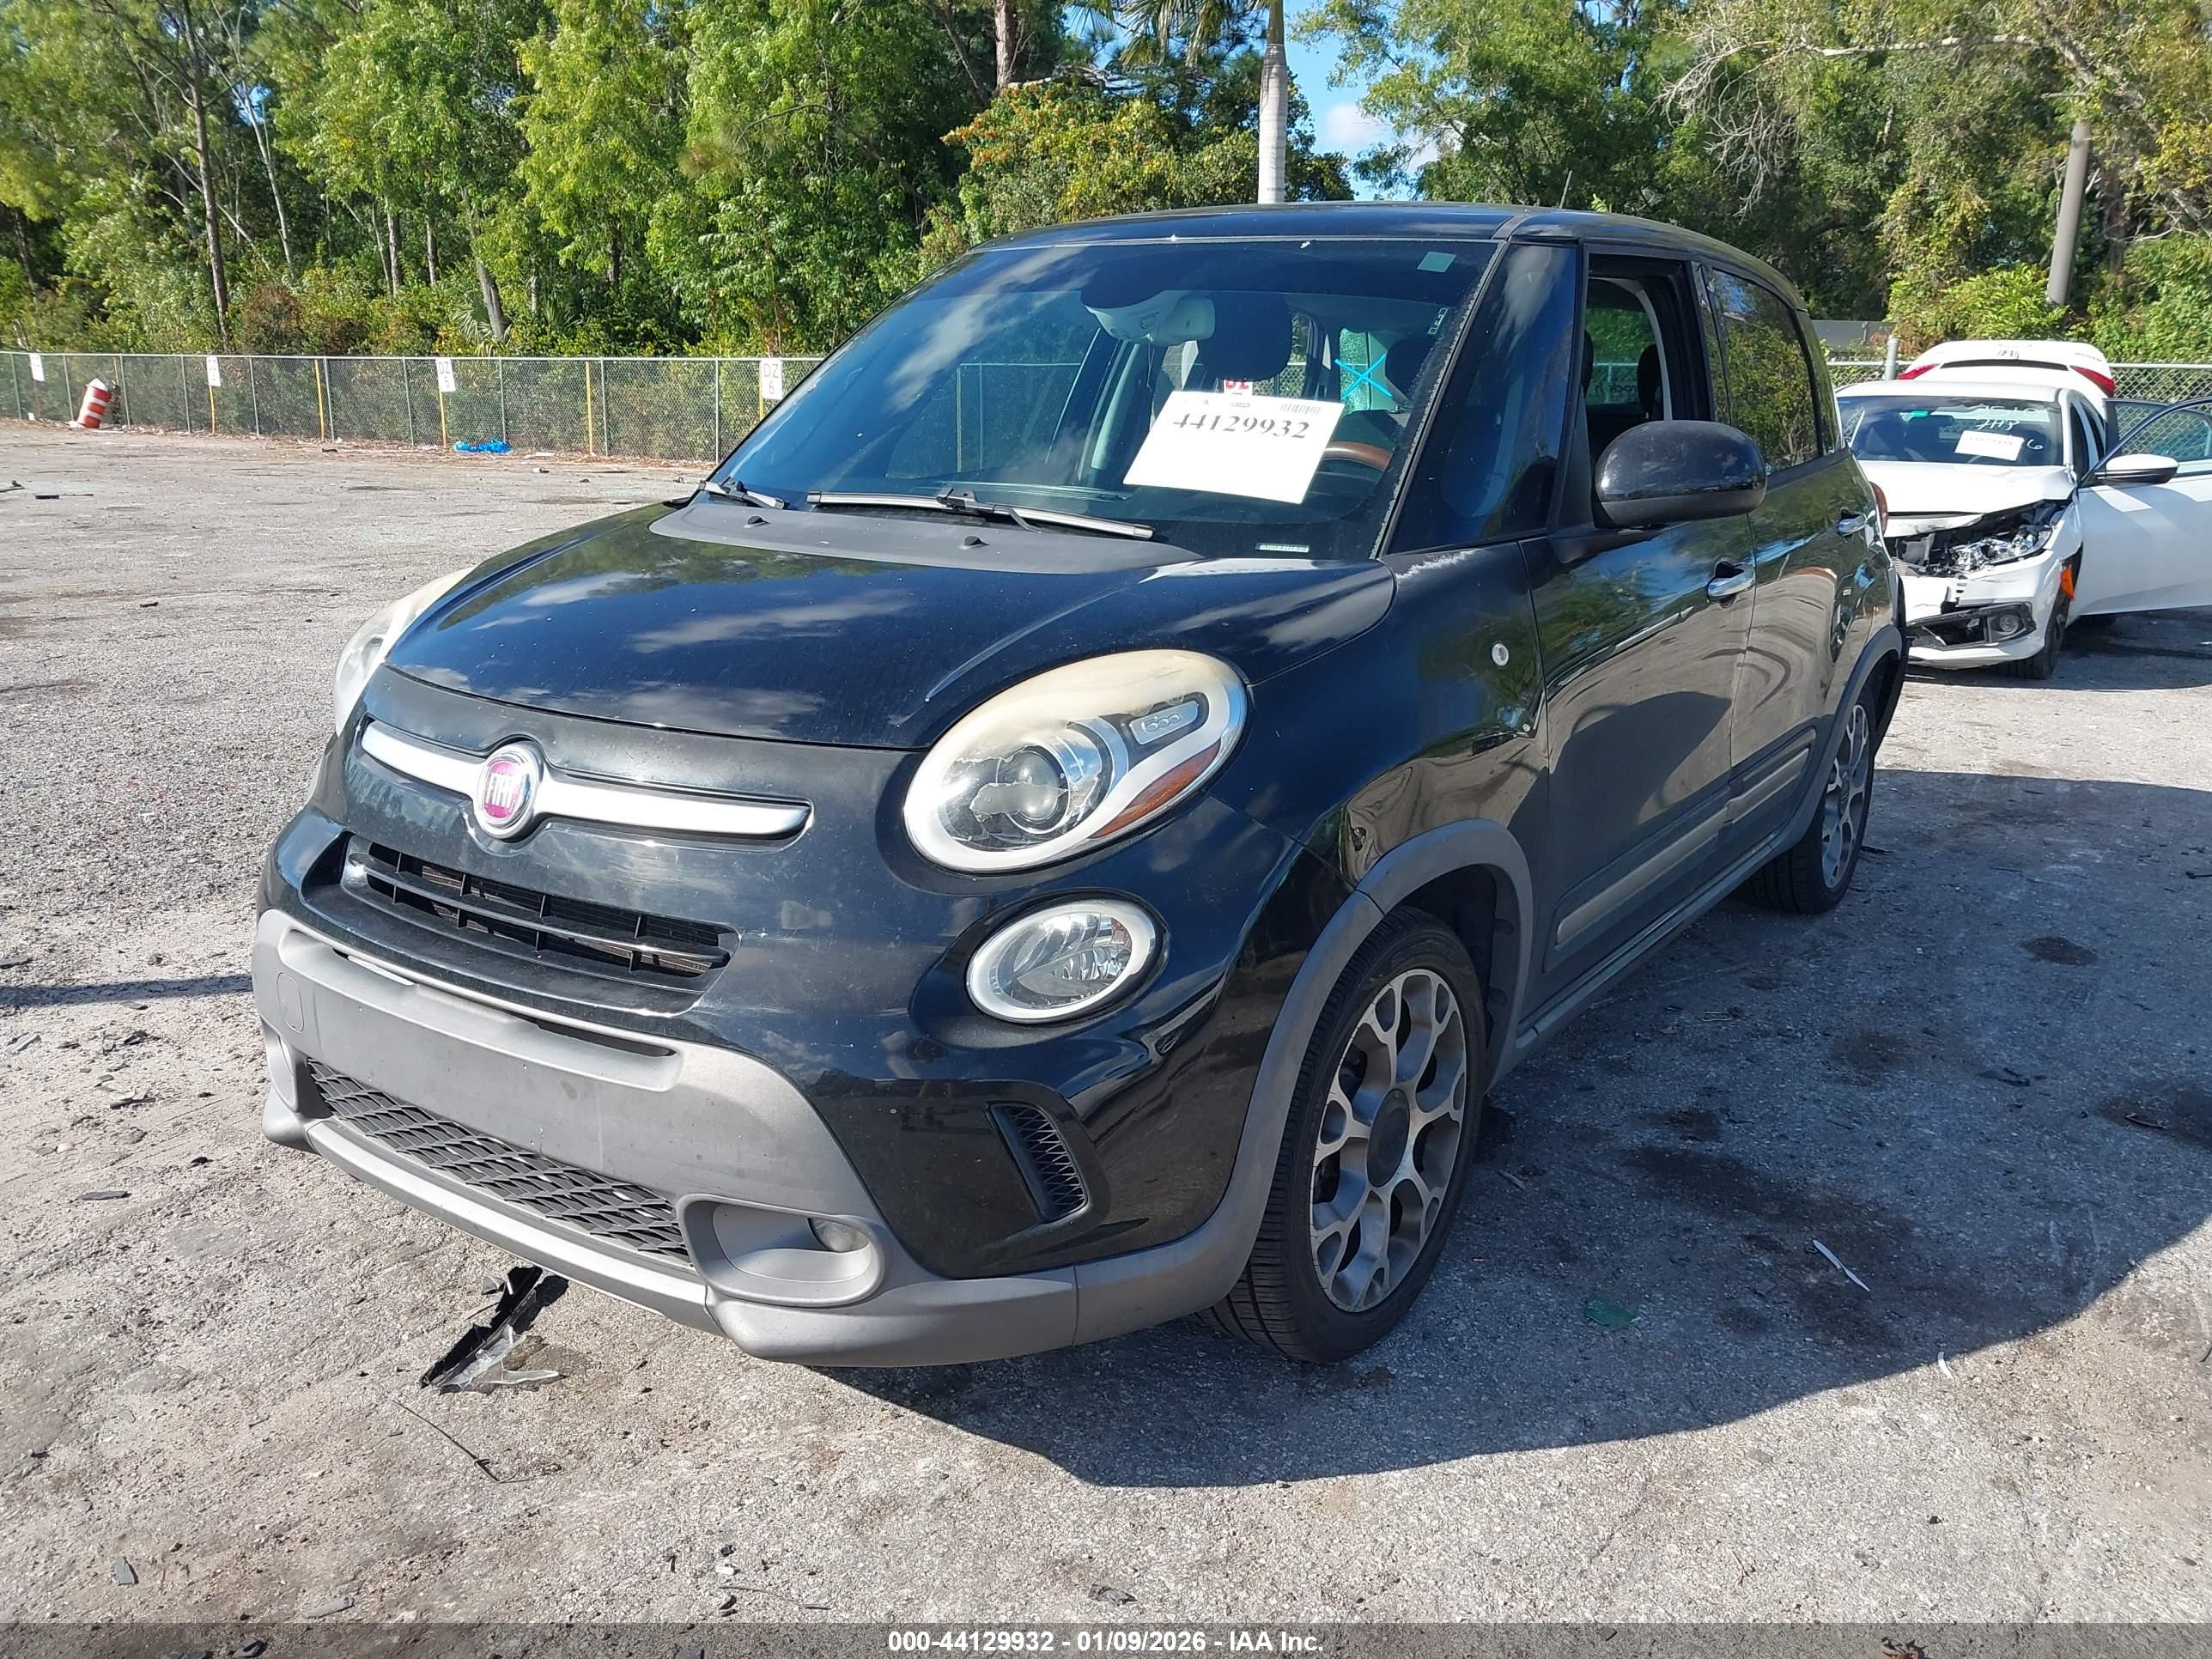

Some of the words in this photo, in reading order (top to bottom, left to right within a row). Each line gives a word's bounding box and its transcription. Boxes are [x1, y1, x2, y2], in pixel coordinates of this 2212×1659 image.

[763, 363, 779, 378] DZ
[769, 380, 775, 394] 6
[1172, 412, 1310, 439] 44129932
